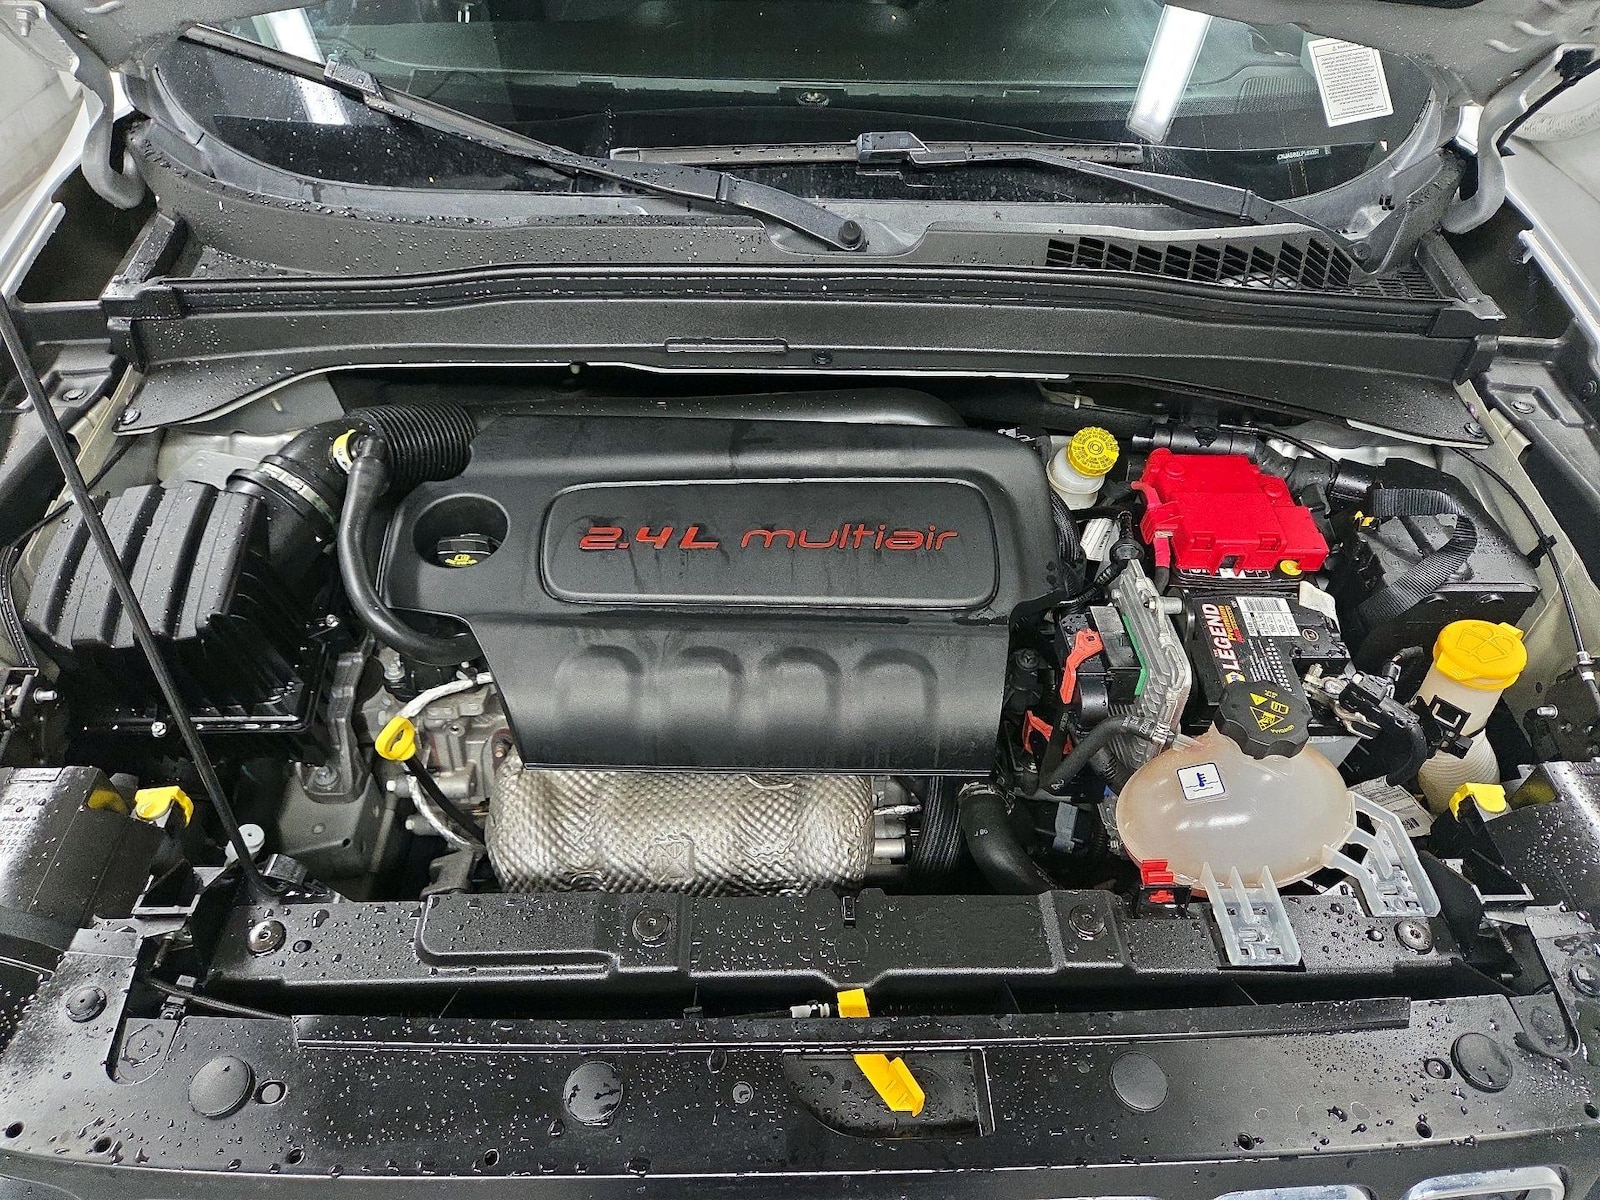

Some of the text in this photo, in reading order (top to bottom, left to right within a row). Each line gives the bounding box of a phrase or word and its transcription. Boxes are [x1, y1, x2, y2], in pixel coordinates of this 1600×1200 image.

[740, 524, 959, 550] multiair
[1202, 603, 1242, 671] LEGEND
[1218, 605, 1237, 642] Premium
